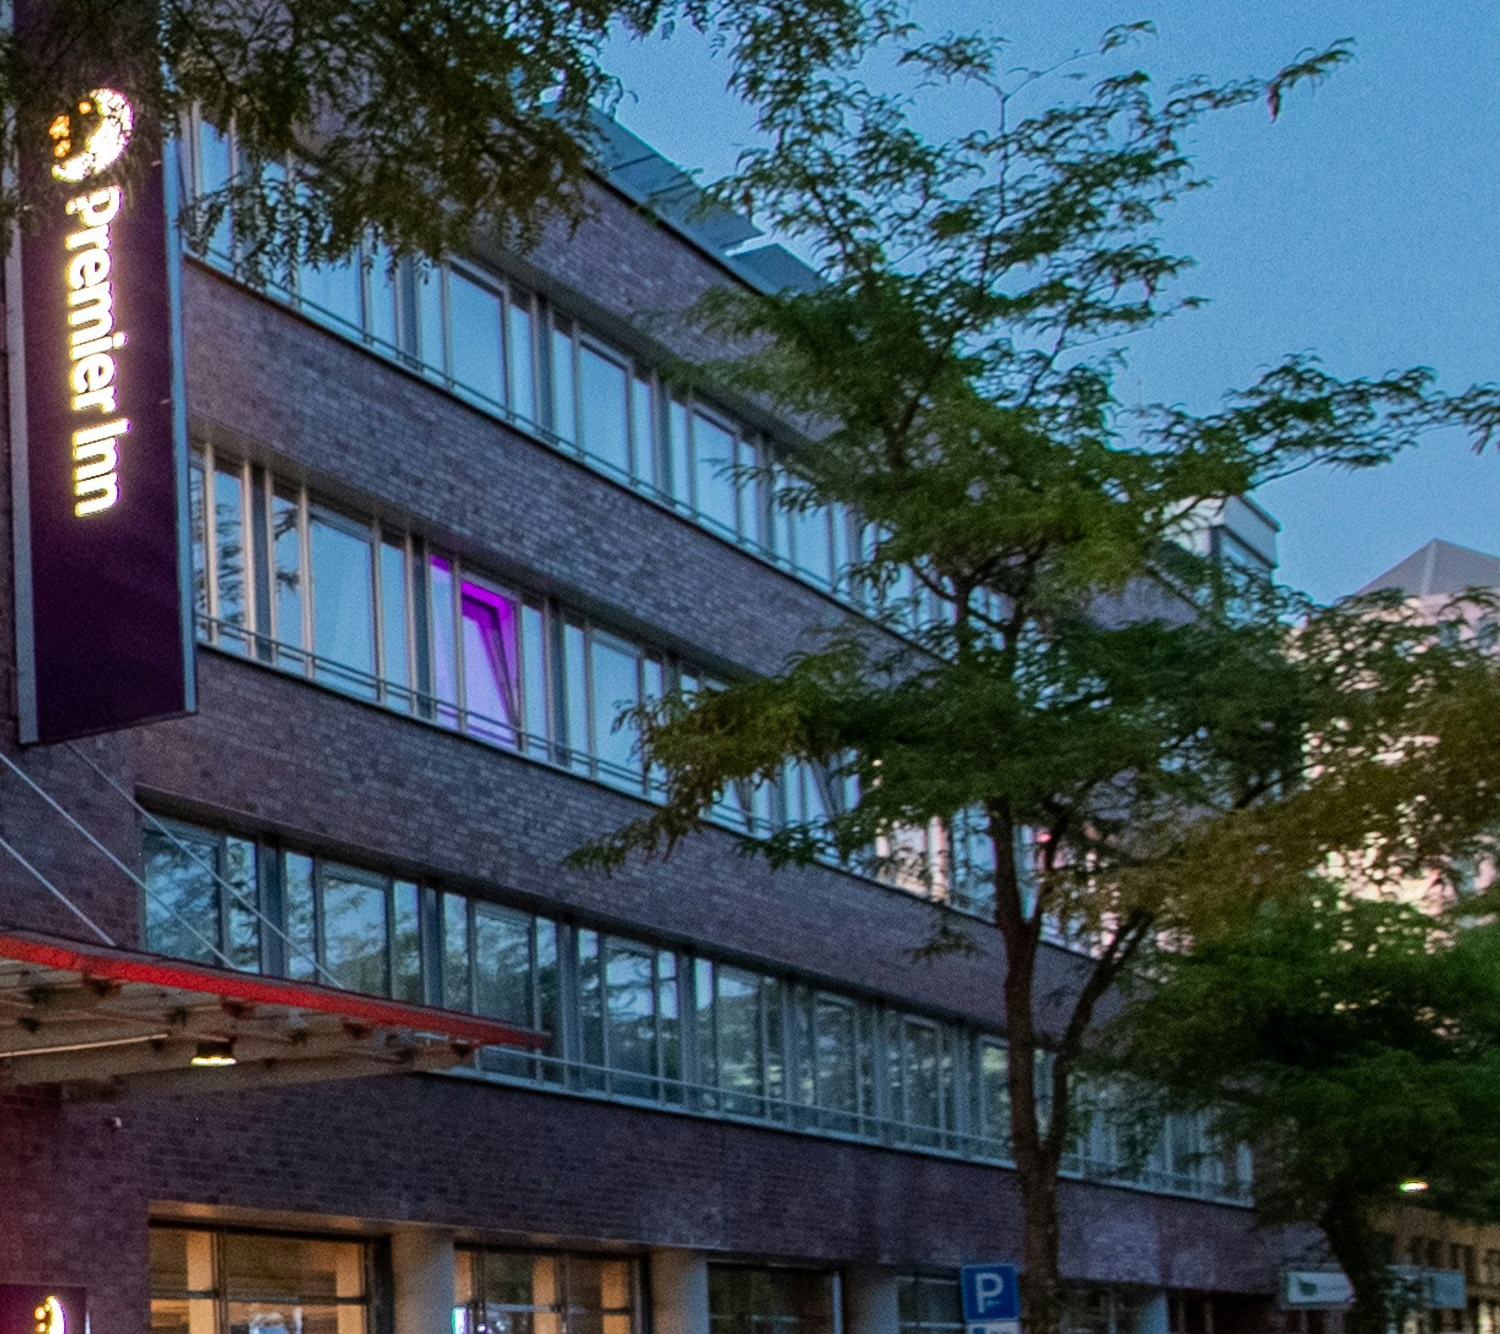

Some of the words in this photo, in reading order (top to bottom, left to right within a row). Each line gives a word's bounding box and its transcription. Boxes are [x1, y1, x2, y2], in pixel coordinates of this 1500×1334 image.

[65, 186, 128, 414] Premier
[73, 418, 132, 517] Inn
[976, 1272, 1004, 1313] P
